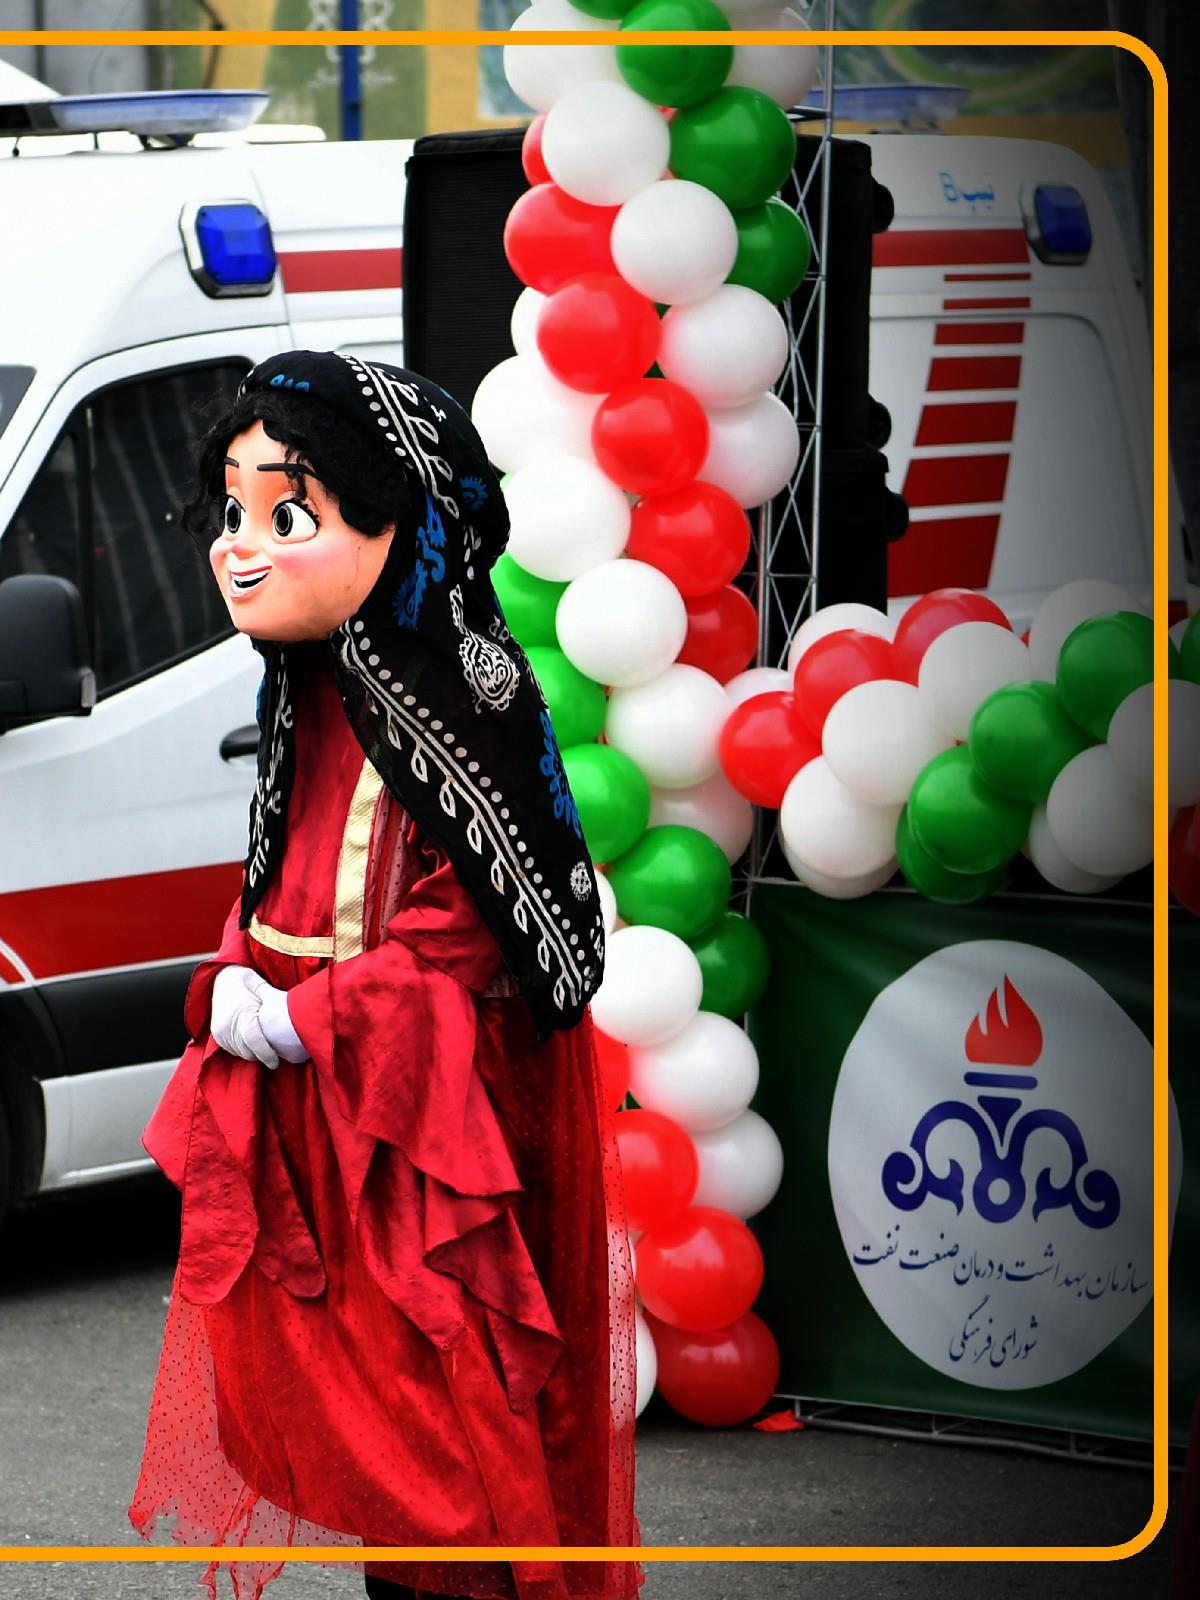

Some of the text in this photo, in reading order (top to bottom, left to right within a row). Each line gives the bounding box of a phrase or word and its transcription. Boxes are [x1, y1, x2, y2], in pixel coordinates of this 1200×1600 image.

[852, 1223, 900, 1266] نفت
[898, 1231, 961, 1270] صنعت
[953, 1255, 996, 1286] درمان
[1004, 1241, 1087, 1298] بهداشت
[1084, 1261, 1150, 1300] سازمان
[948, 1293, 1039, 1369] شورای فرهنگی
